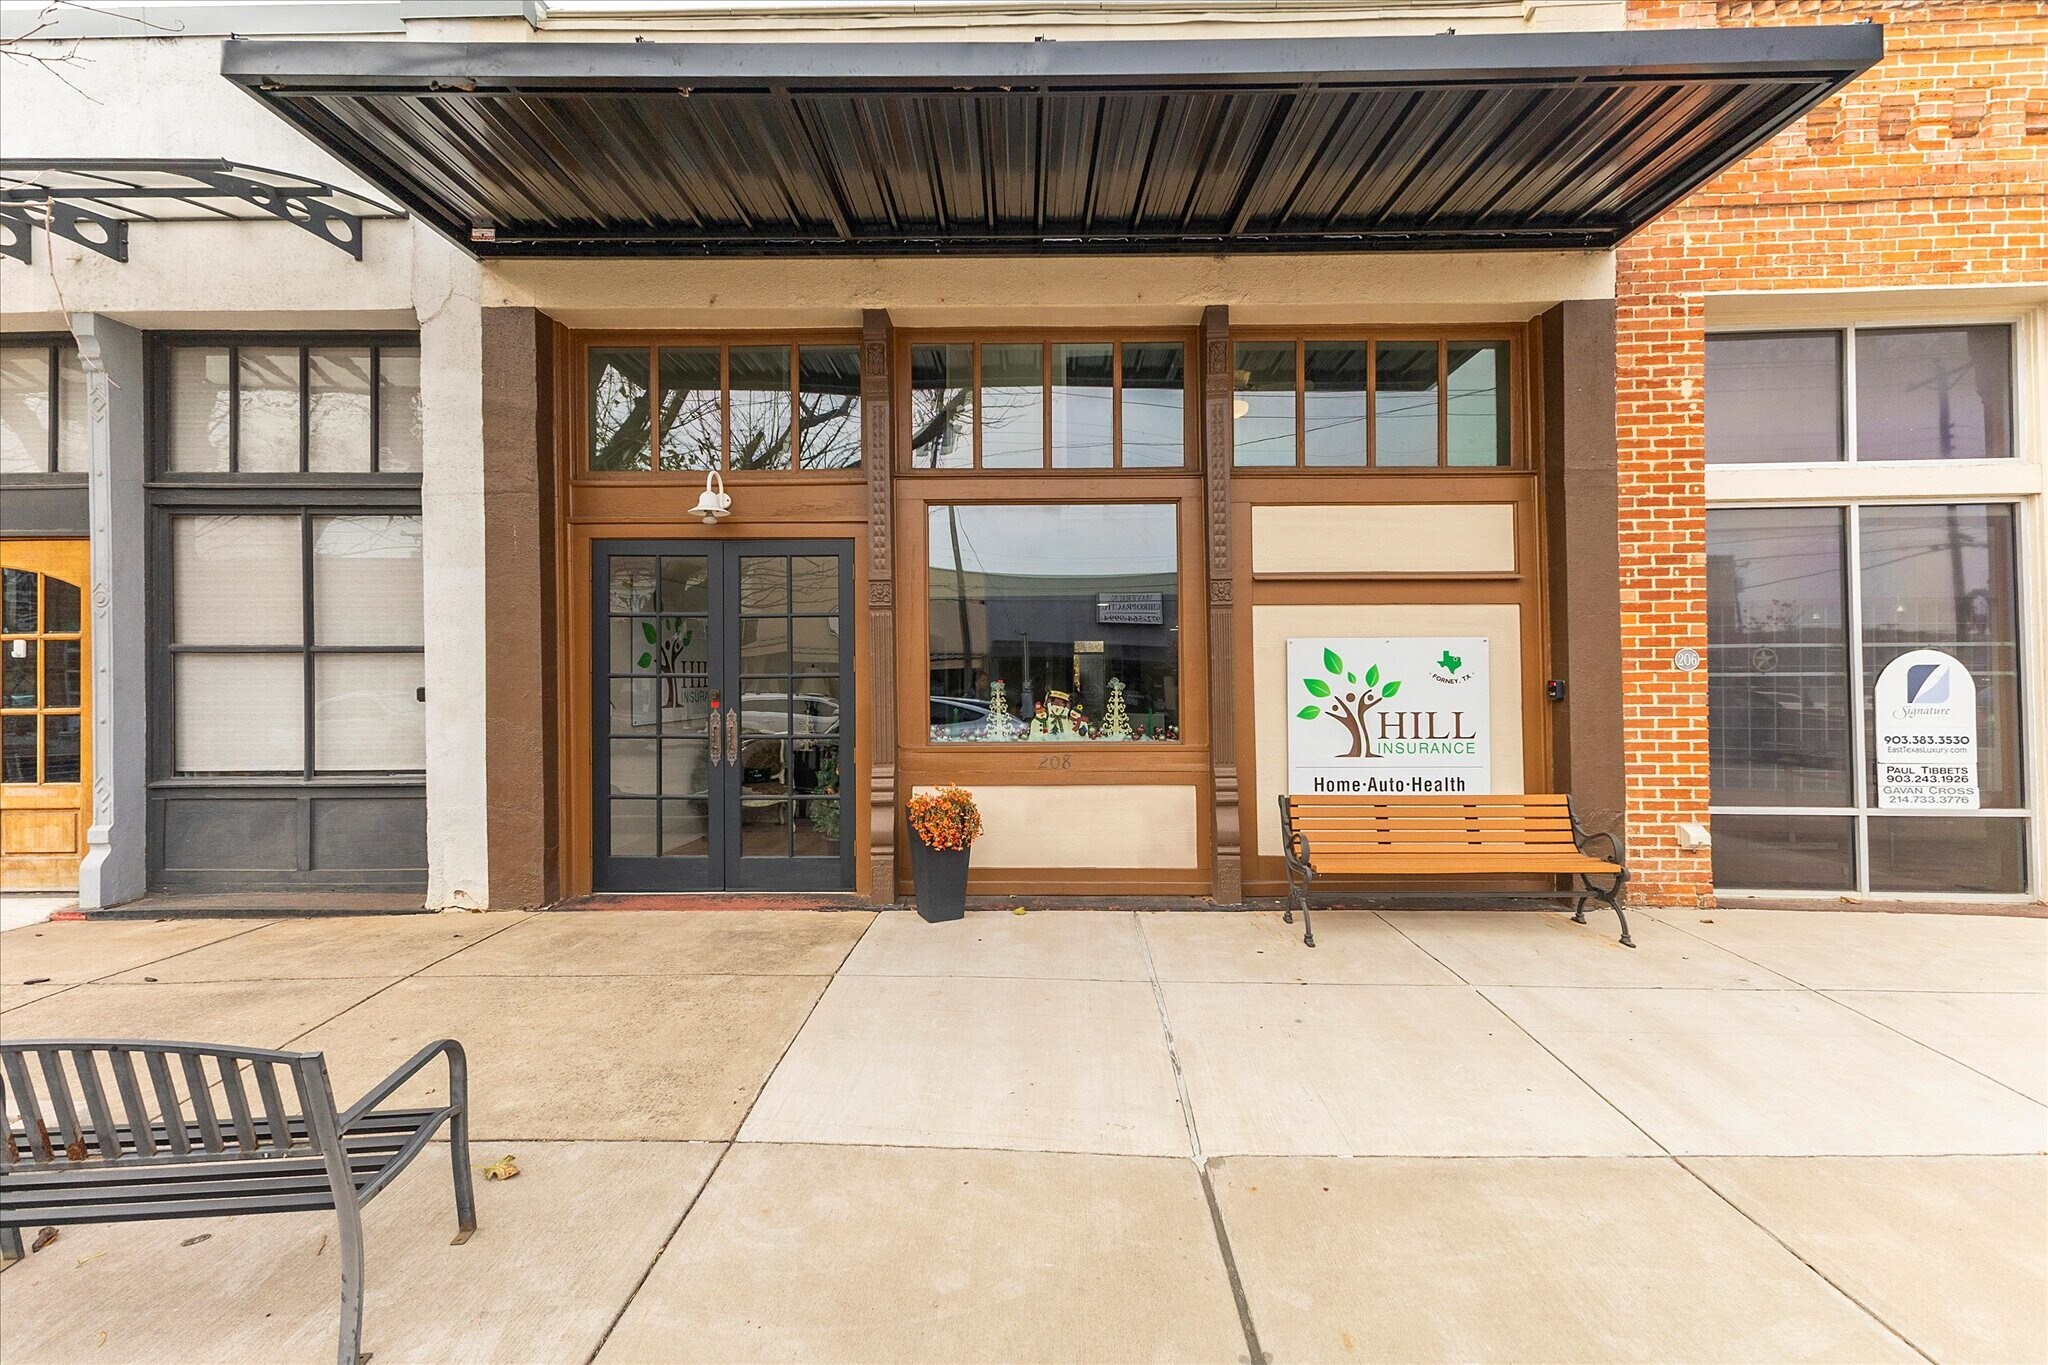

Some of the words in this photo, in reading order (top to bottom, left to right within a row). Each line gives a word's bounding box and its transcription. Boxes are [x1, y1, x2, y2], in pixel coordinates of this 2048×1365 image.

[1678, 653, 1697, 666] 206
[1461, 673, 1472, 682] TX
[1892, 705, 1951, 720] Signature
[1377, 711, 1477, 740] HILL
[1884, 735, 1970, 745] 903.383.3530
[1377, 742, 1475, 755] INSURANCE
[1887, 746, 1968, 754] EastTexasLuxury.com
[1038, 753, 1072, 770] 208
[1886, 766, 1915, 775] PAUL
[1920, 765, 1969, 775] TIBBETS
[1886, 775, 1969, 784] 903.243.1926
[1883, 785, 1923, 795] GAVAN
[1928, 785, 1975, 795] CROSS
[1889, 795, 1969, 804] 214.733.3776
